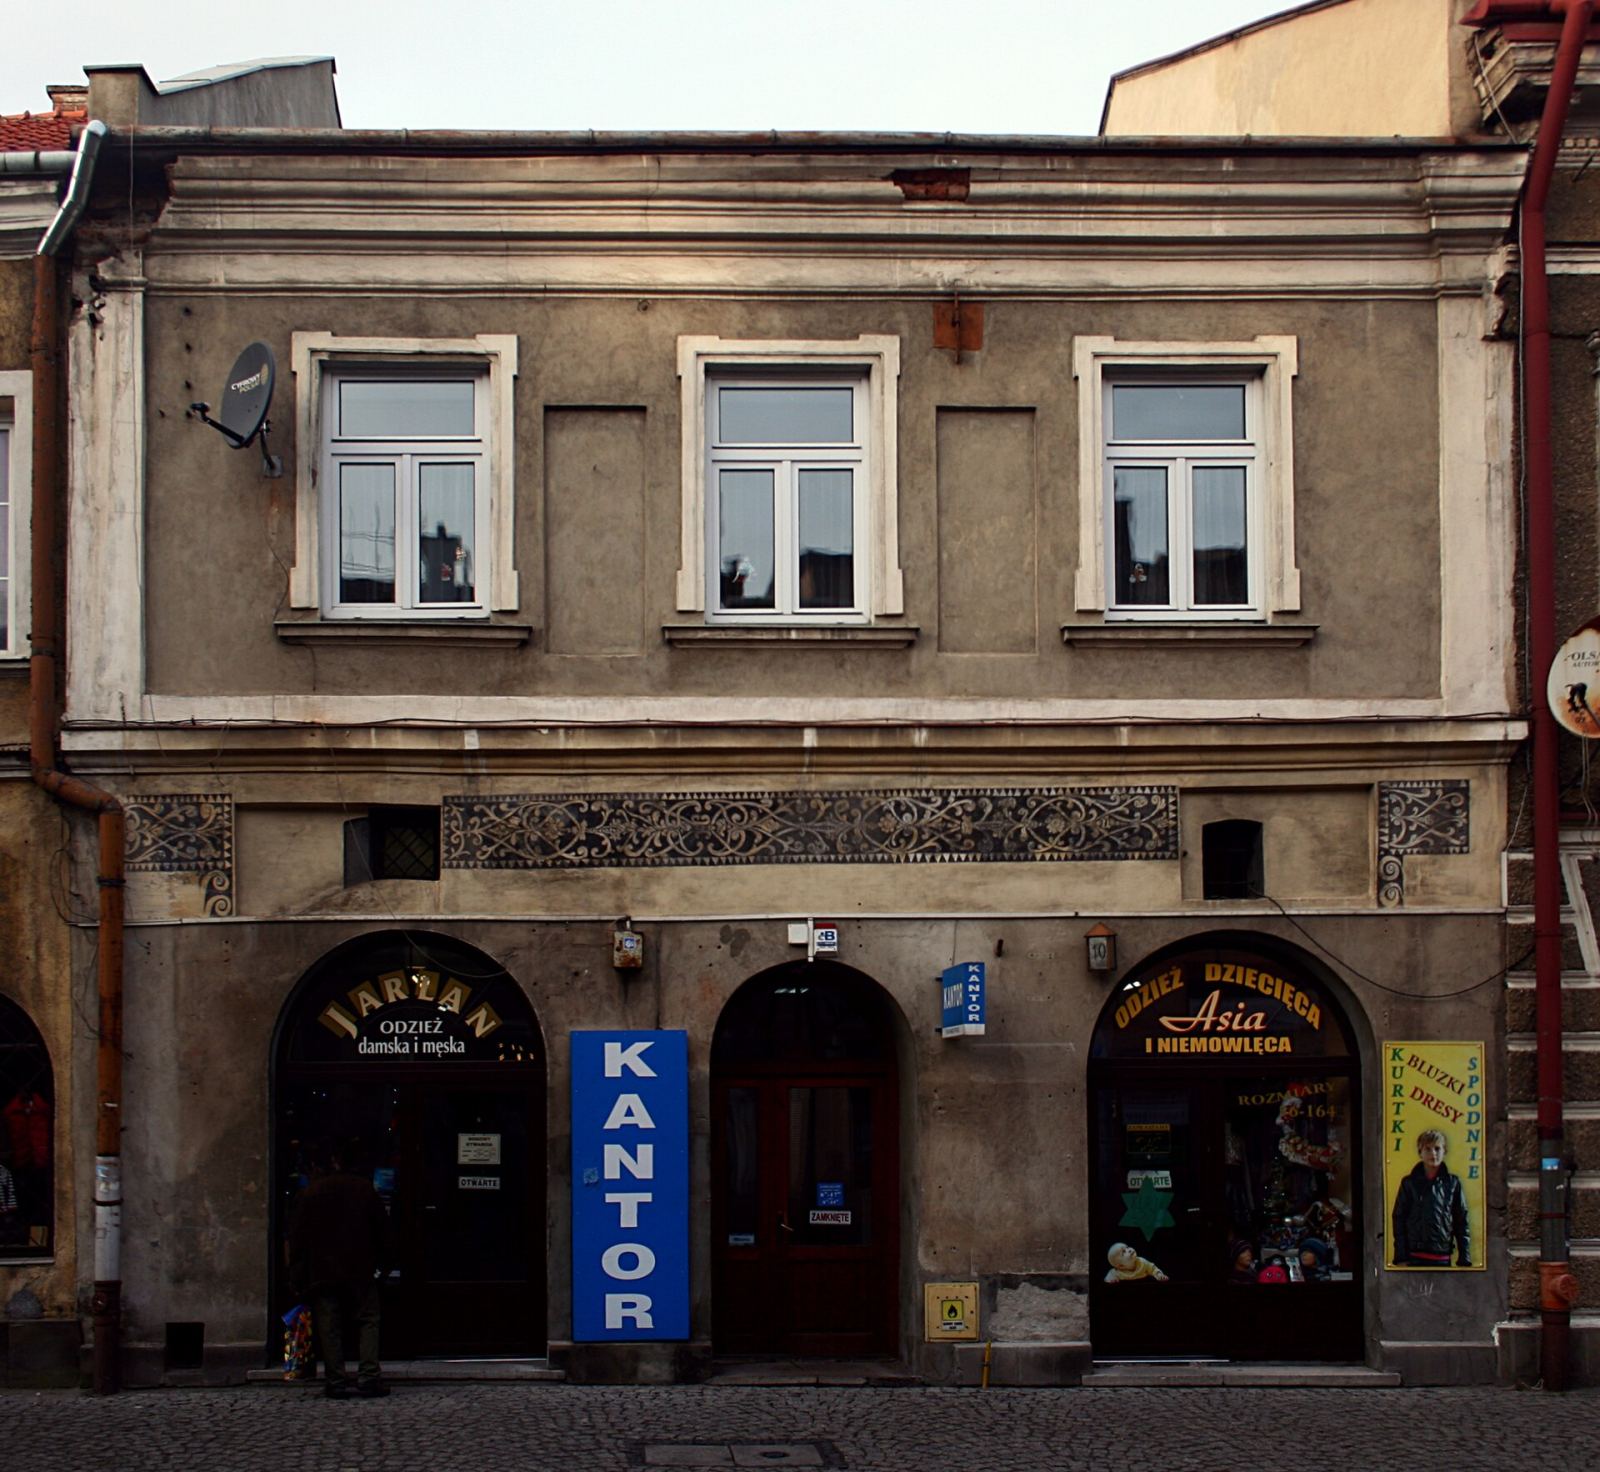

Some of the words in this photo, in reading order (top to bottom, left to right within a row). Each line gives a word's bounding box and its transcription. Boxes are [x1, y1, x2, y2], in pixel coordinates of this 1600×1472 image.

[943, 982, 963, 1010] KANTOR
[967, 964, 981, 1022] KANTOR
[1113, 964, 1185, 1031] ODZIEŻ
[1204, 962, 1322, 1032] DZIECIĘCA
[1158, 988, 1268, 1032] Asia
[379, 1016, 443, 1034] ODZIEŻ
[1145, 1036, 1153, 1054] I
[1156, 1035, 1293, 1056] NIEMOWLĘCA
[358, 1036, 410, 1054] damska
[413, 1036, 419, 1054] i
[423, 1035, 466, 1058] męska
[1407, 1053, 1466, 1096] BLUZKI
[1390, 1047, 1405, 1152] KURTKI
[1409, 1085, 1464, 1124] DRESY
[1466, 1056, 1481, 1179] SPODNIE
[461, 1178, 497, 1187] OTWARTE
[600, 1040, 658, 1330] KANTOR
[811, 1212, 850, 1223] ZAMKNIĘTE
